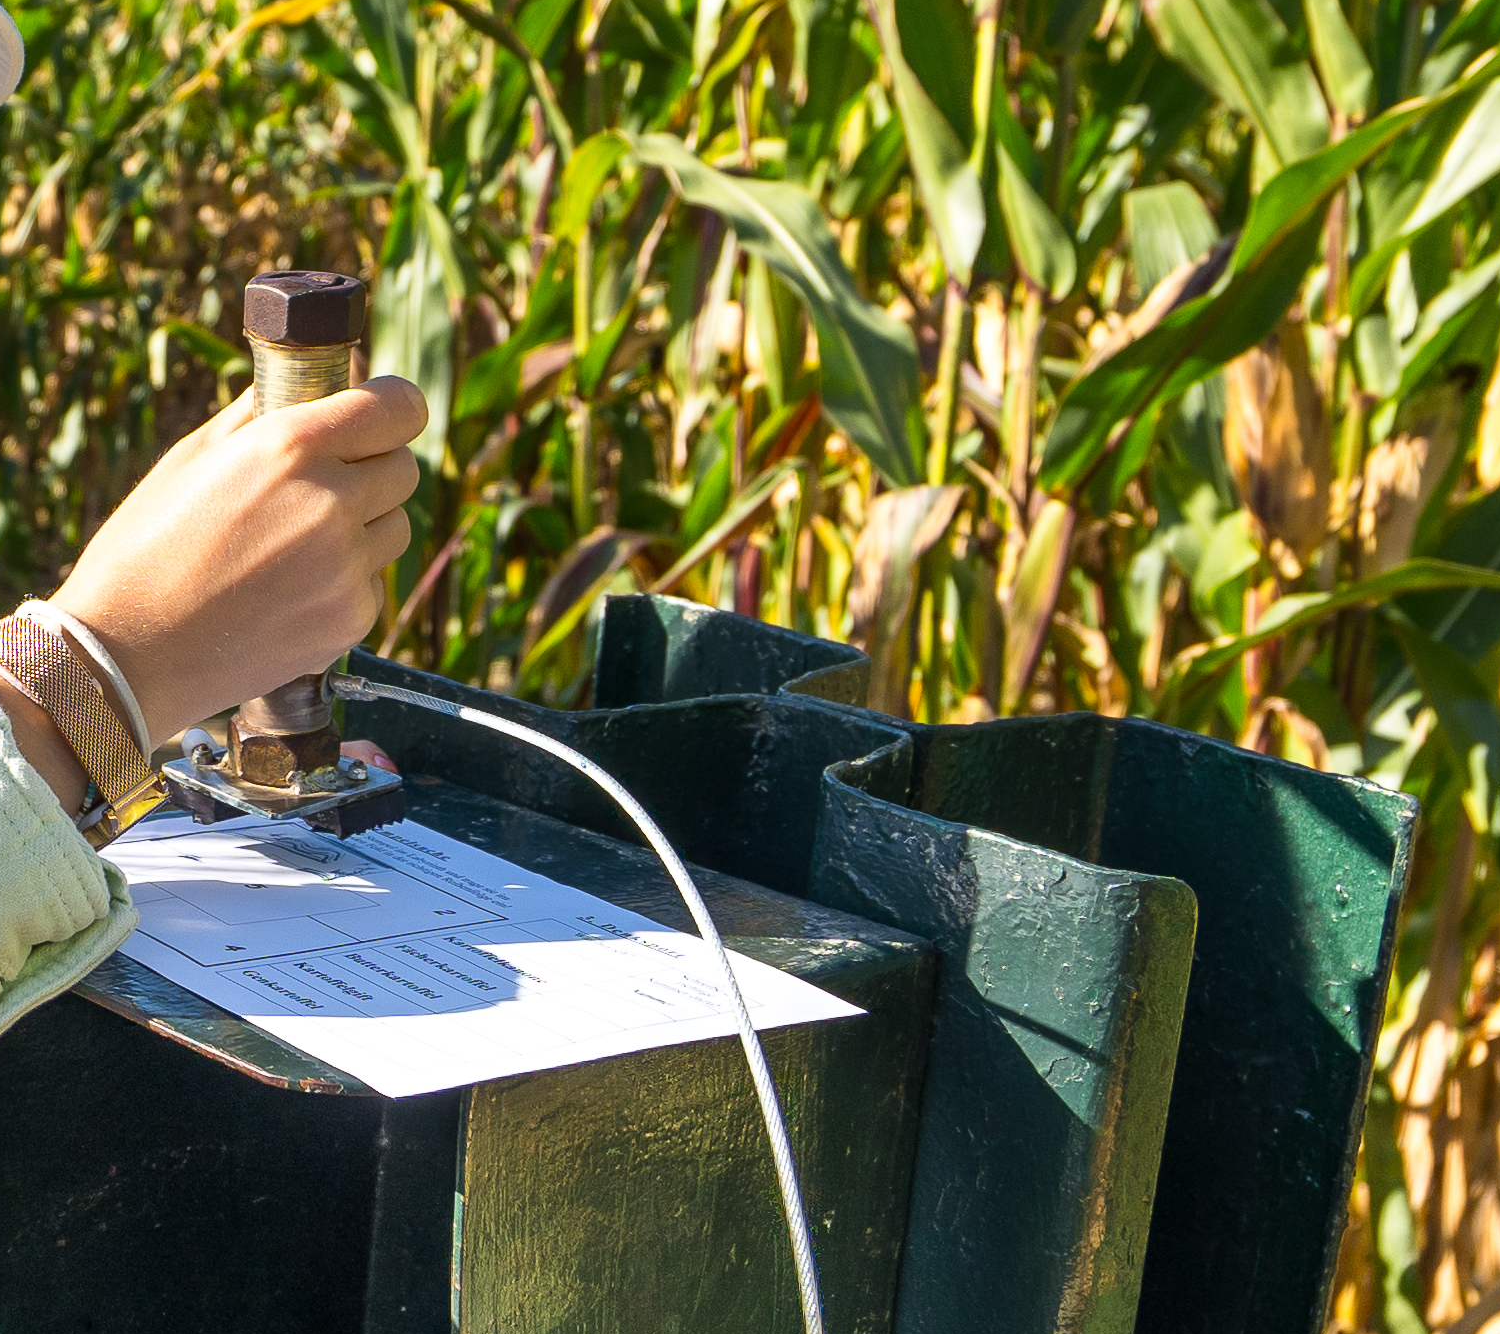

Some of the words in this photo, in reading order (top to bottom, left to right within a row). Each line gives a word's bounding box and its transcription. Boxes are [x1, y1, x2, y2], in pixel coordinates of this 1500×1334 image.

[242, 969, 325, 1011] Genkartoffel
[292, 961, 375, 1002] Kartoffelgift
[343, 952, 444, 1001] Butterkartoffel
[394, 943, 499, 993] Fächerkartoffel
